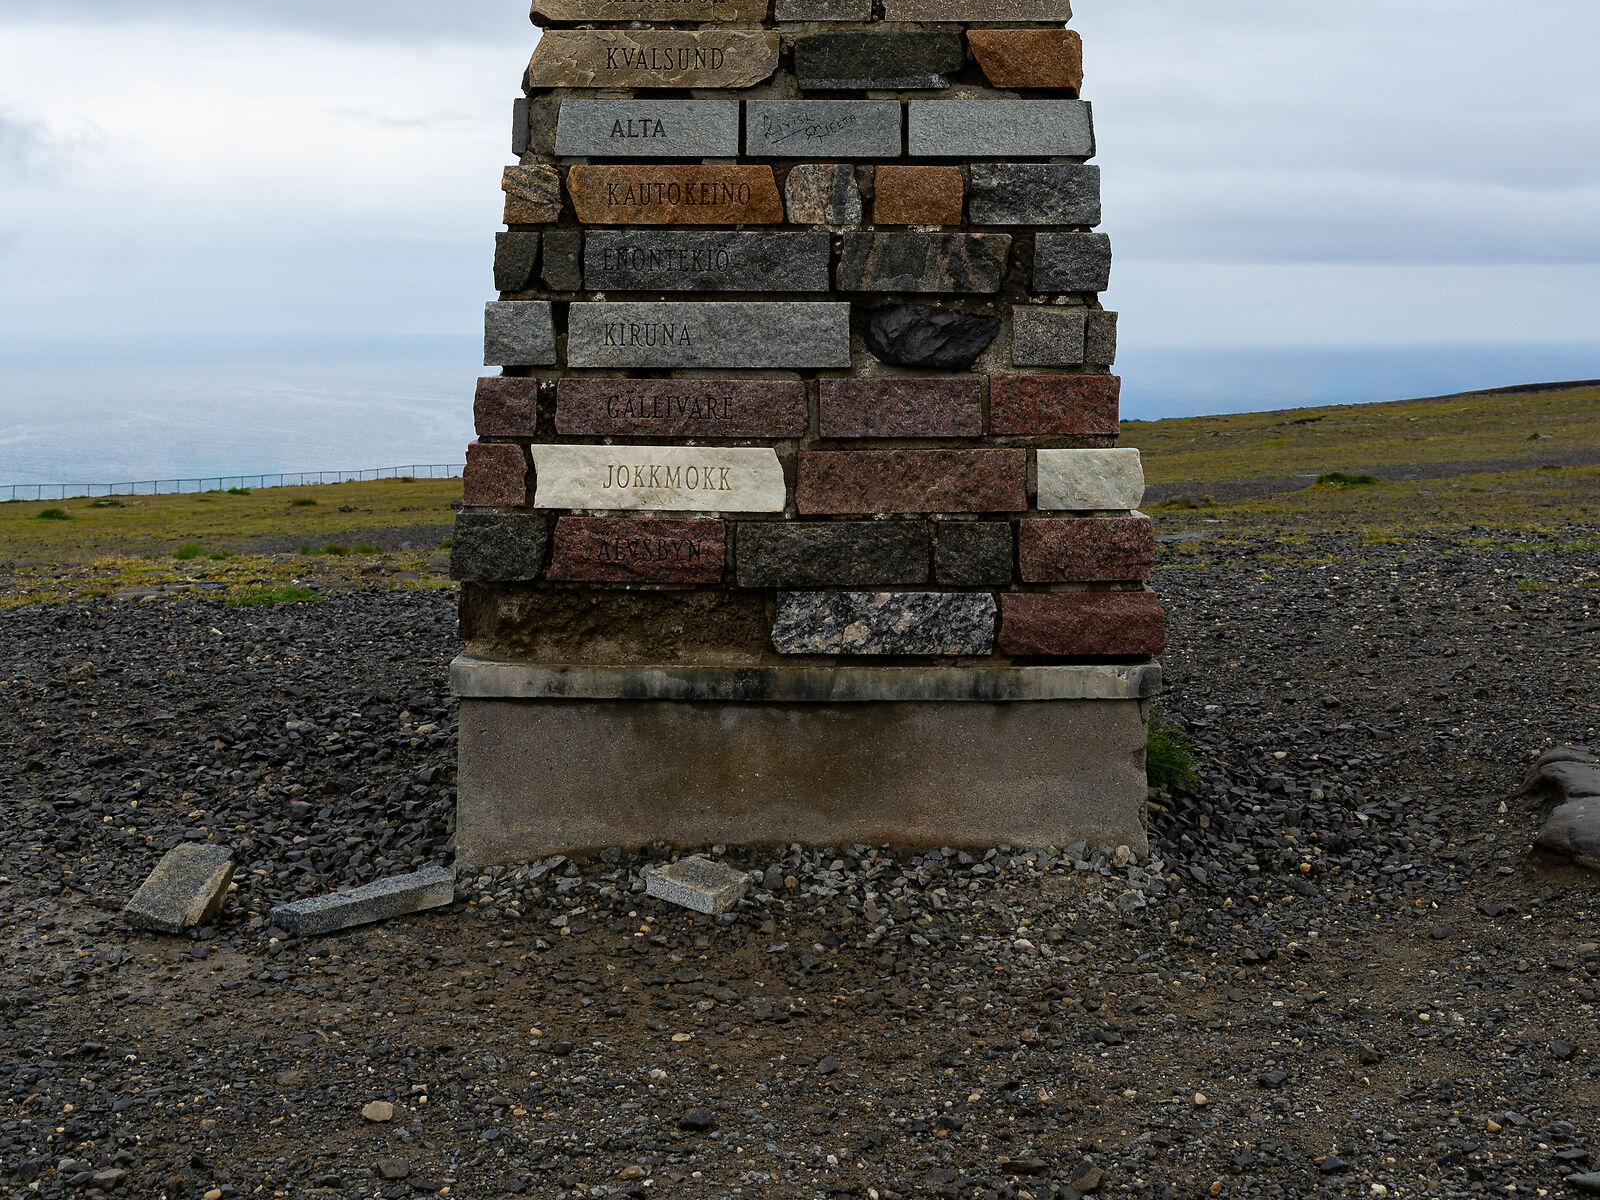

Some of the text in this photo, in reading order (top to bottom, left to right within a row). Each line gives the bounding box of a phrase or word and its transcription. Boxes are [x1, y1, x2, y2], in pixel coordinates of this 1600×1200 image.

[605, 47, 724, 71] KVALSUND
[610, 118, 667, 138] ALTA
[607, 182, 751, 206] KAUTOKEINO
[603, 244, 729, 272] ENONTEKIÖ
[603, 323, 691, 347] KIRUNA
[605, 390, 734, 420] GÄLLIVARE
[603, 464, 732, 491] JOKKMOKK
